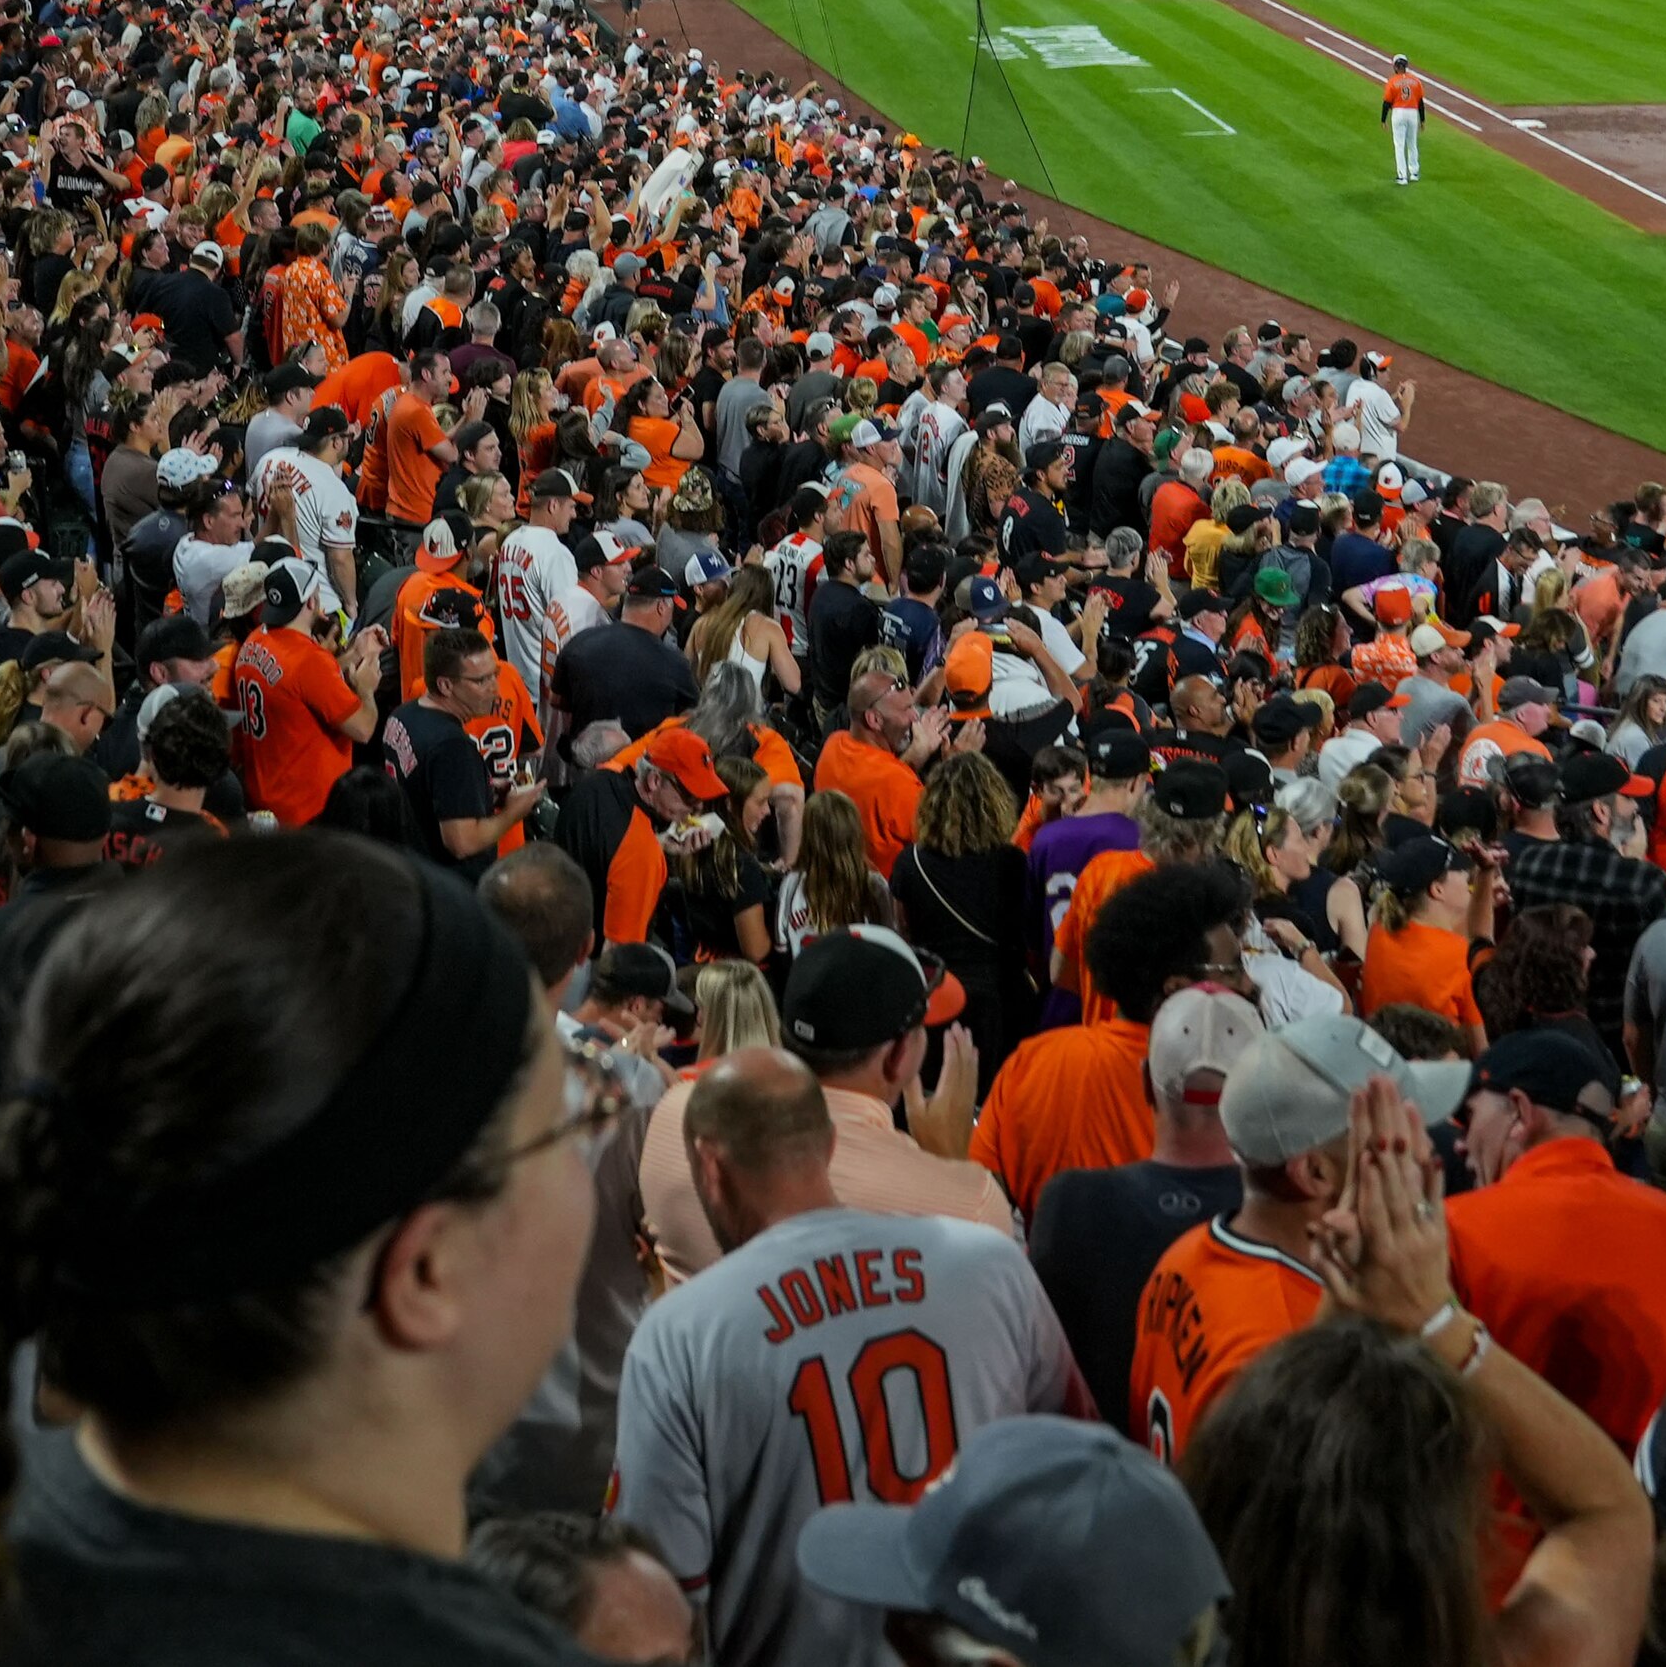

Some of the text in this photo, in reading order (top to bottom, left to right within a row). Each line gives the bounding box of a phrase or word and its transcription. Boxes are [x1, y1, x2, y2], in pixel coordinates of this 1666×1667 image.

[1402, 85, 1411, 101] 9
[498, 574, 534, 620] 35
[237, 676, 266, 740] 13
[757, 1248, 926, 1344] JONES
[1147, 1270, 1210, 1398] RIPKEN
[788, 1327, 960, 1507] 10
